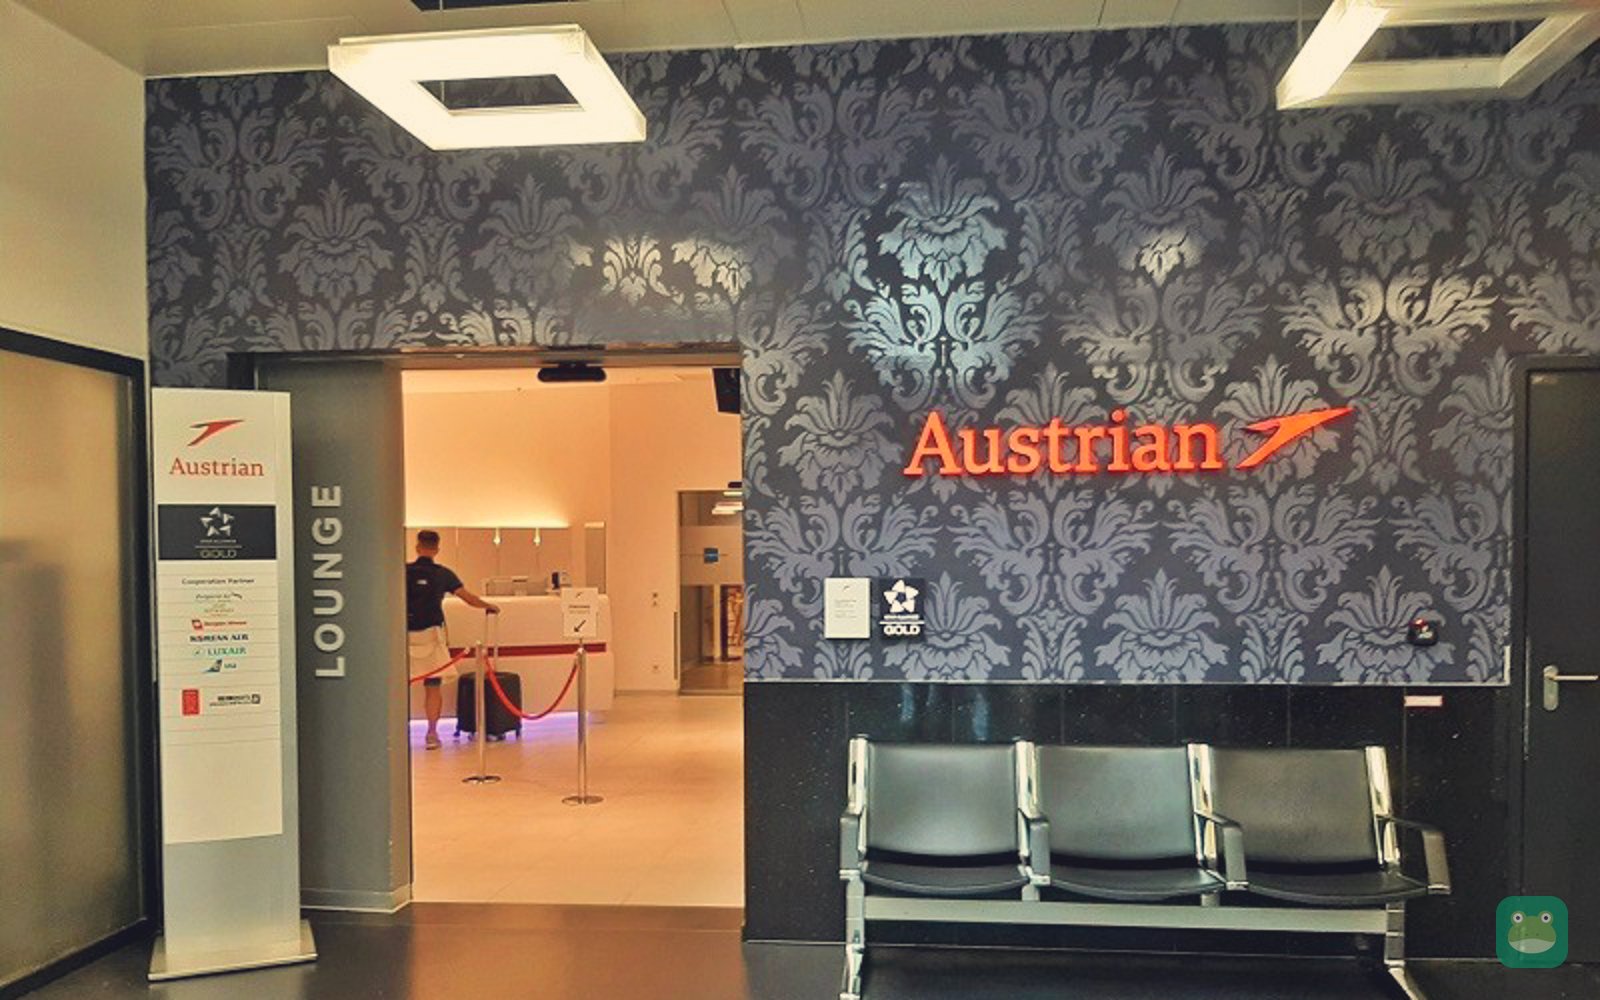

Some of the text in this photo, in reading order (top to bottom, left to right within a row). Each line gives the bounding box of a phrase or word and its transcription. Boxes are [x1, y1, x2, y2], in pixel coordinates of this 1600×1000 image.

[903, 408, 1224, 476] Austrian
[169, 457, 264, 477] Austrian
[311, 485, 345, 678] LOUNGE
[883, 624, 921, 636] GOLD
